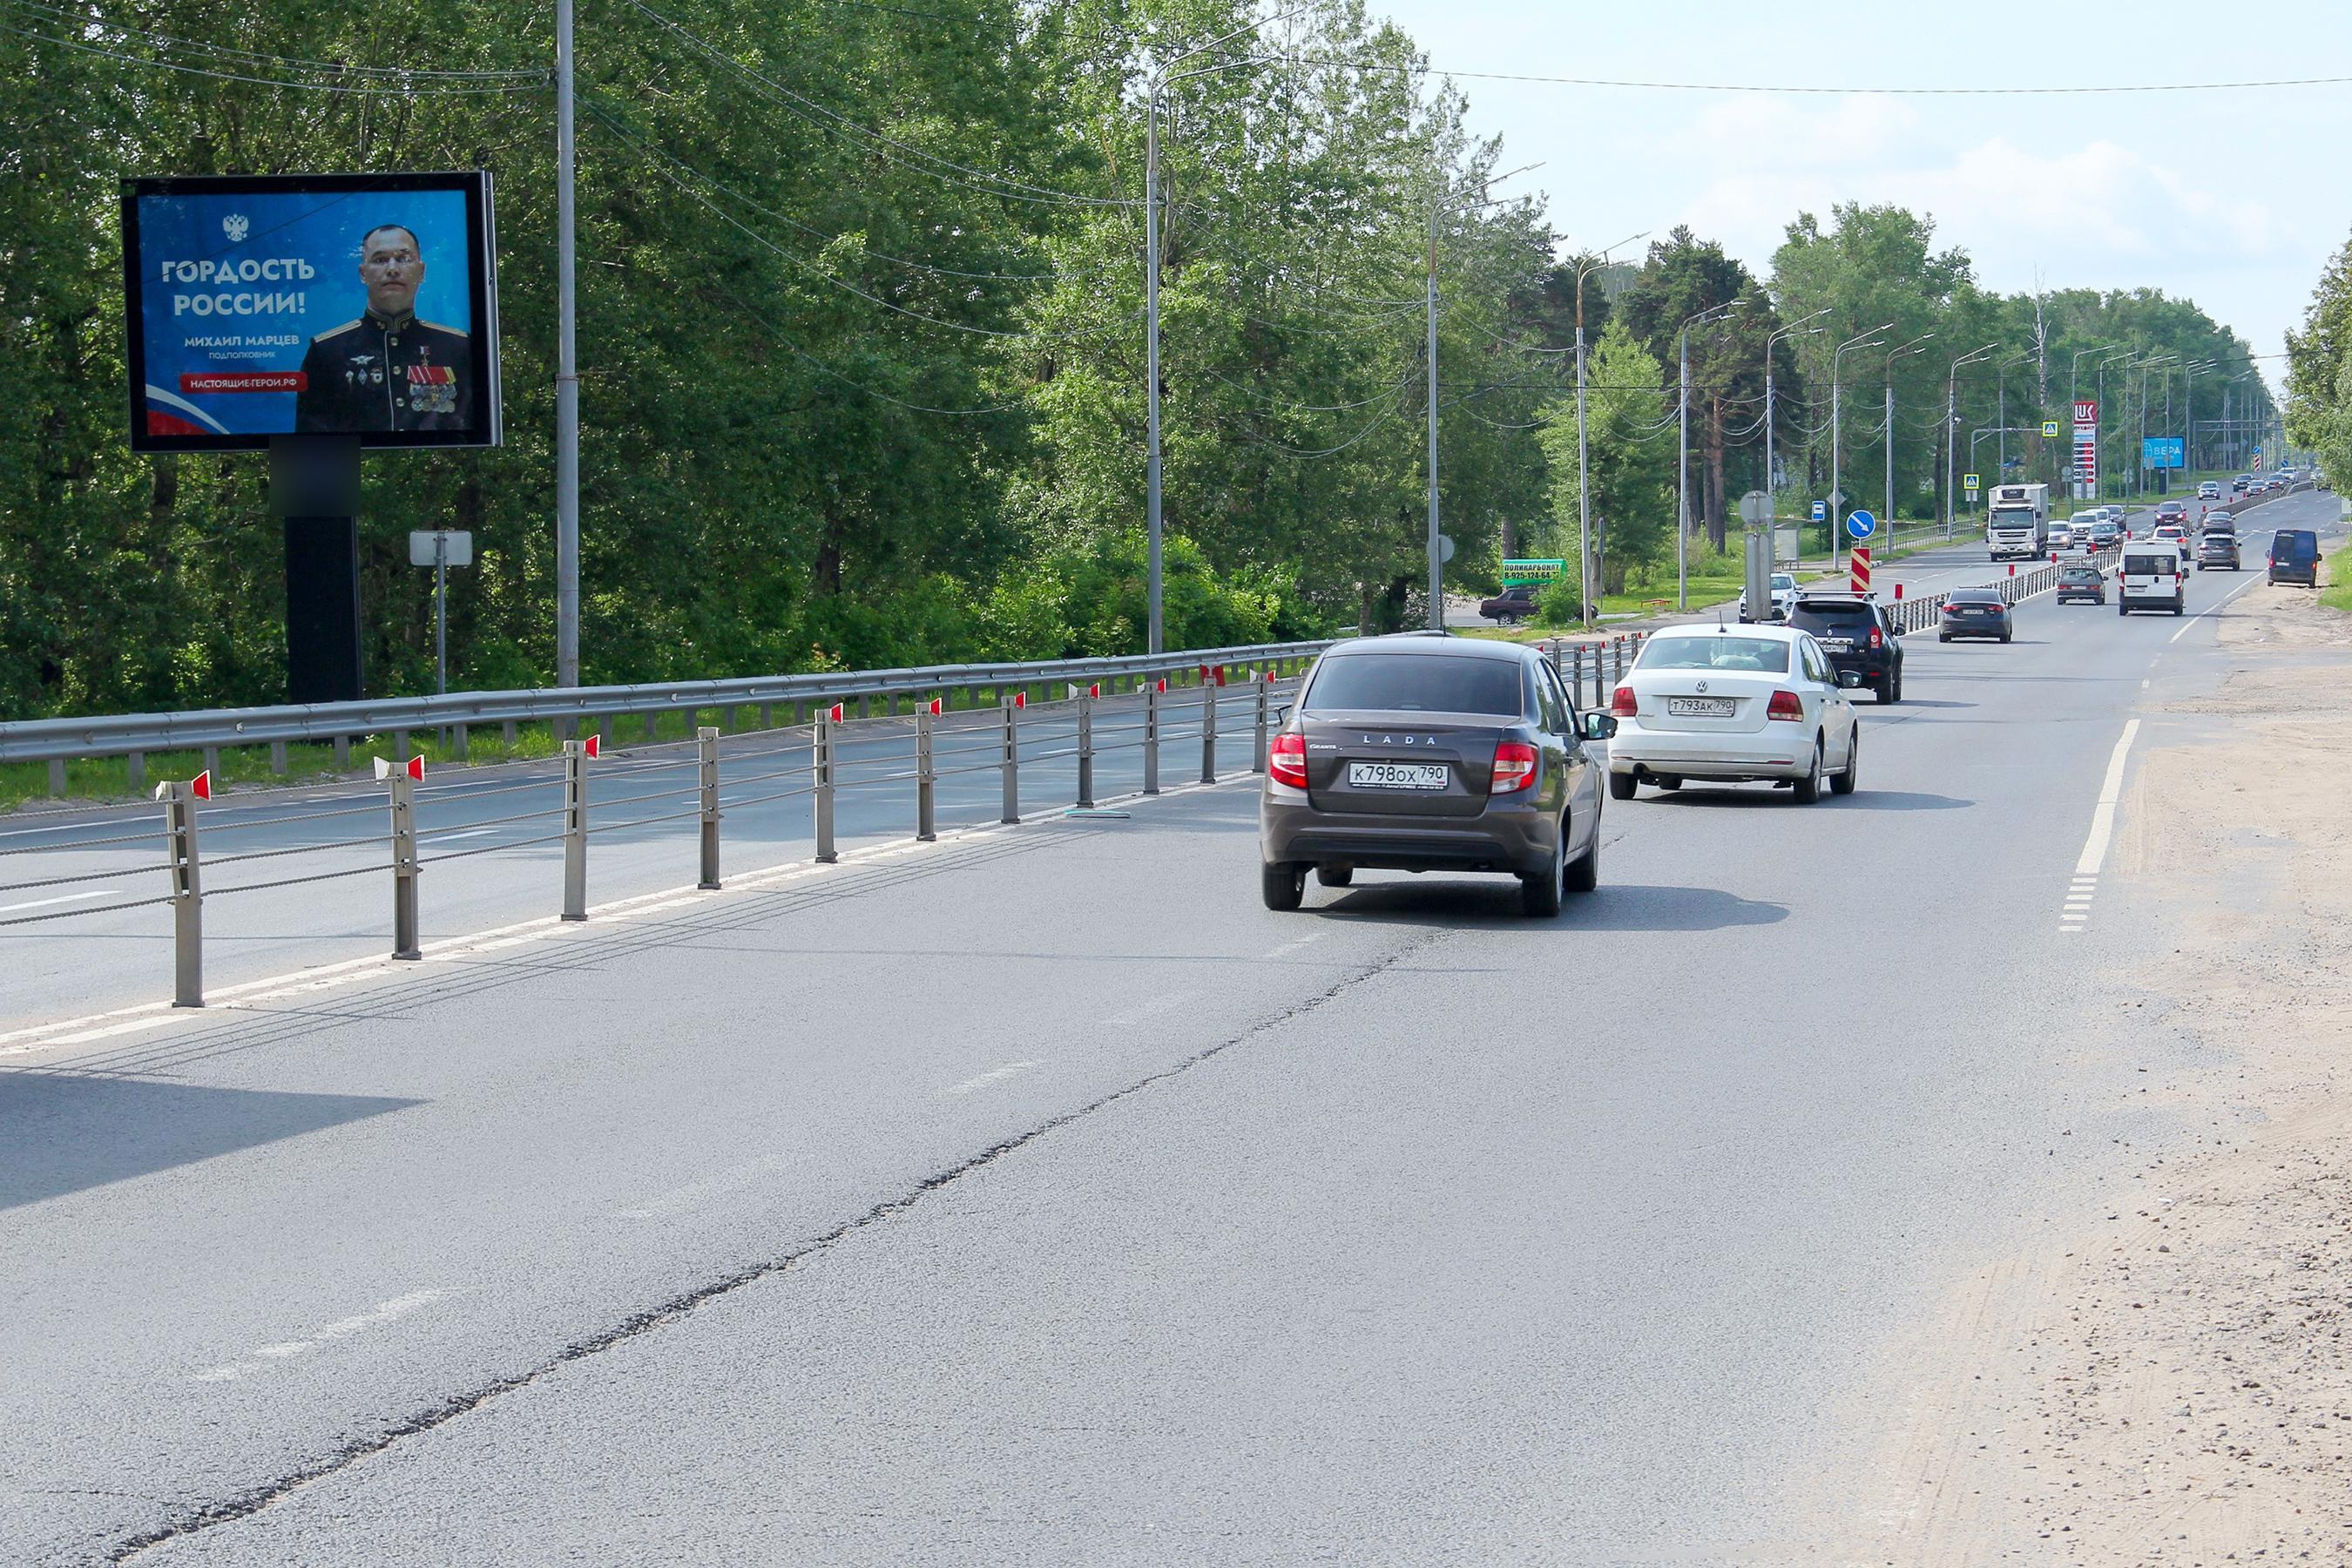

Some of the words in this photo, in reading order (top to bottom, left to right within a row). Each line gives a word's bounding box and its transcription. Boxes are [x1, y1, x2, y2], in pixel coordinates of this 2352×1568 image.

[162, 259, 315, 284] ГОРДОСТЬ
[174, 293, 306, 316] РОССИИ!
[185, 336, 241, 347] МИХАИЛ
[246, 335, 300, 347] МАРЦЕВ
[209, 351, 276, 360] ПОДПОЛКОВНИК
[191, 378, 297, 389] НАСТОЯЩИЕ-ГЕРОИ.РФ
[2153, 445, 2181, 456] ВЕРА
[1673, 700, 1713, 711] Т793АК
[1715, 700, 1731, 709] 790
[1363, 735, 1436, 745] LADA
[1355, 766, 1416, 782] К798ОХ
[1420, 767, 1443, 780] 790
